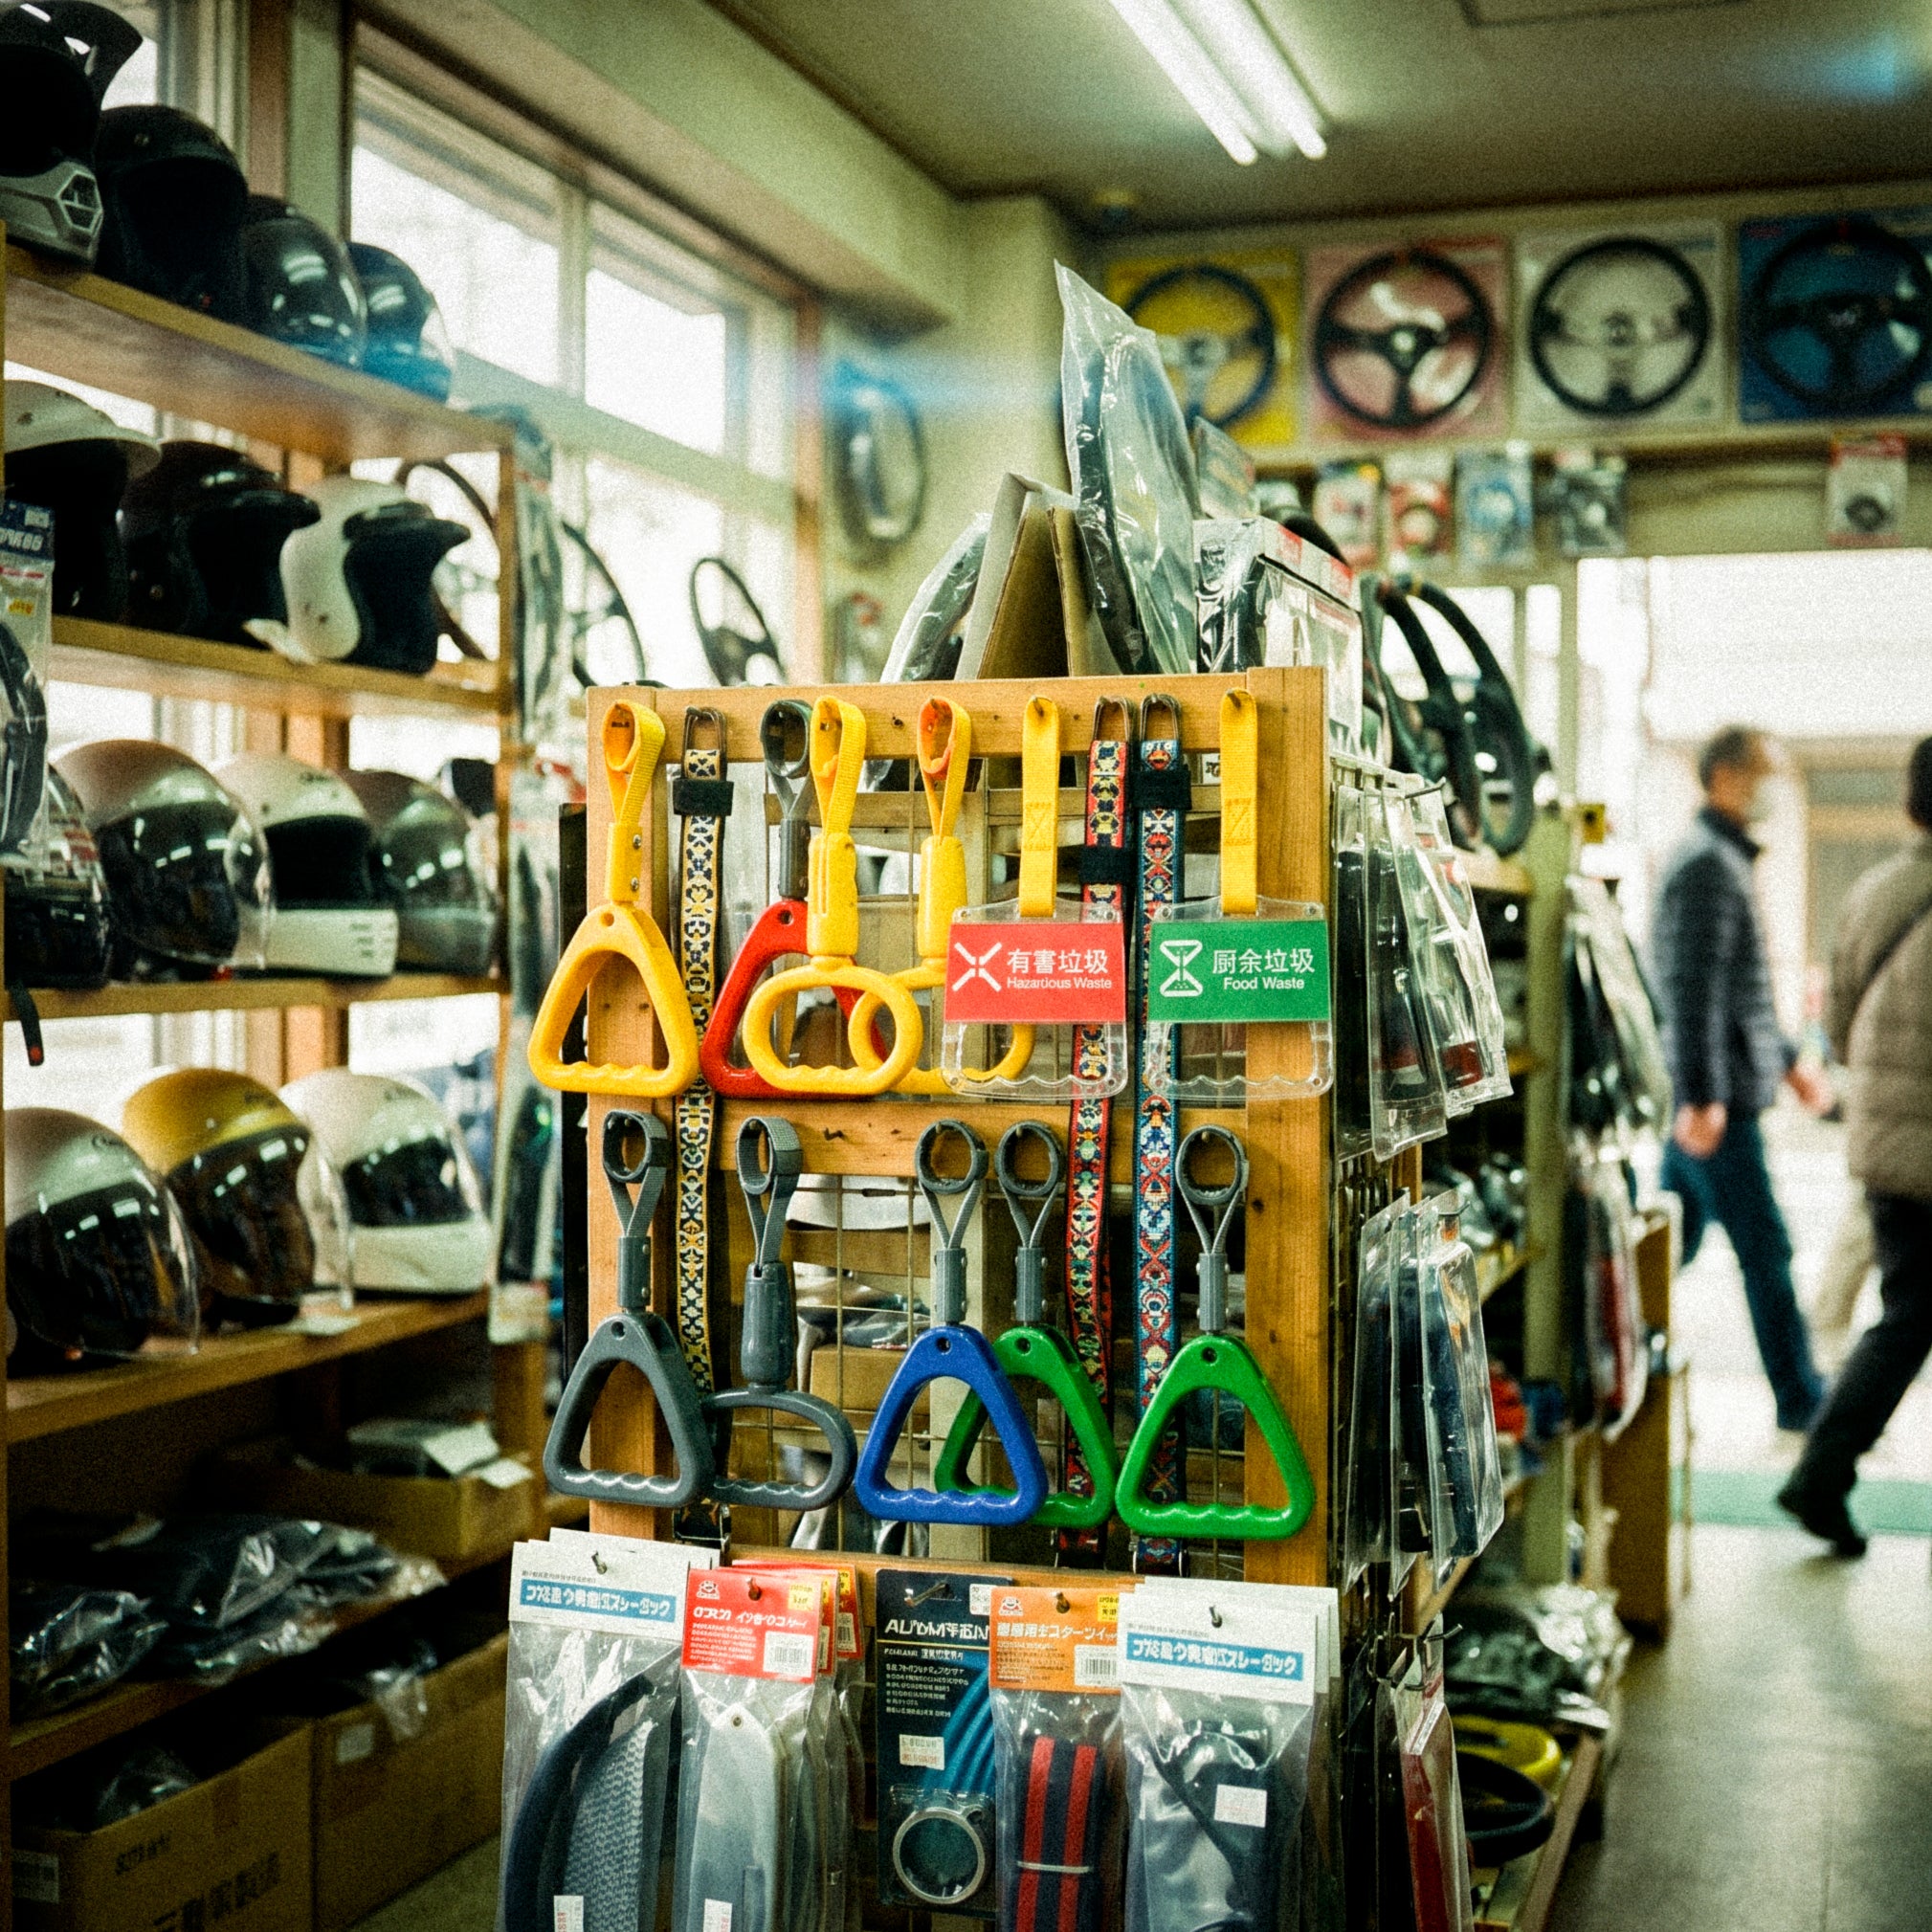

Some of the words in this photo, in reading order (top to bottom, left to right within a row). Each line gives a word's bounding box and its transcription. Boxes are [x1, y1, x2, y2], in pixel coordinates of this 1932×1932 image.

[1212, 948, 1315, 974] 厨余垃圾
[1074, 976, 1112, 988] Waste
[1224, 976, 1257, 989] Food
[1262, 976, 1304, 989] Waste
